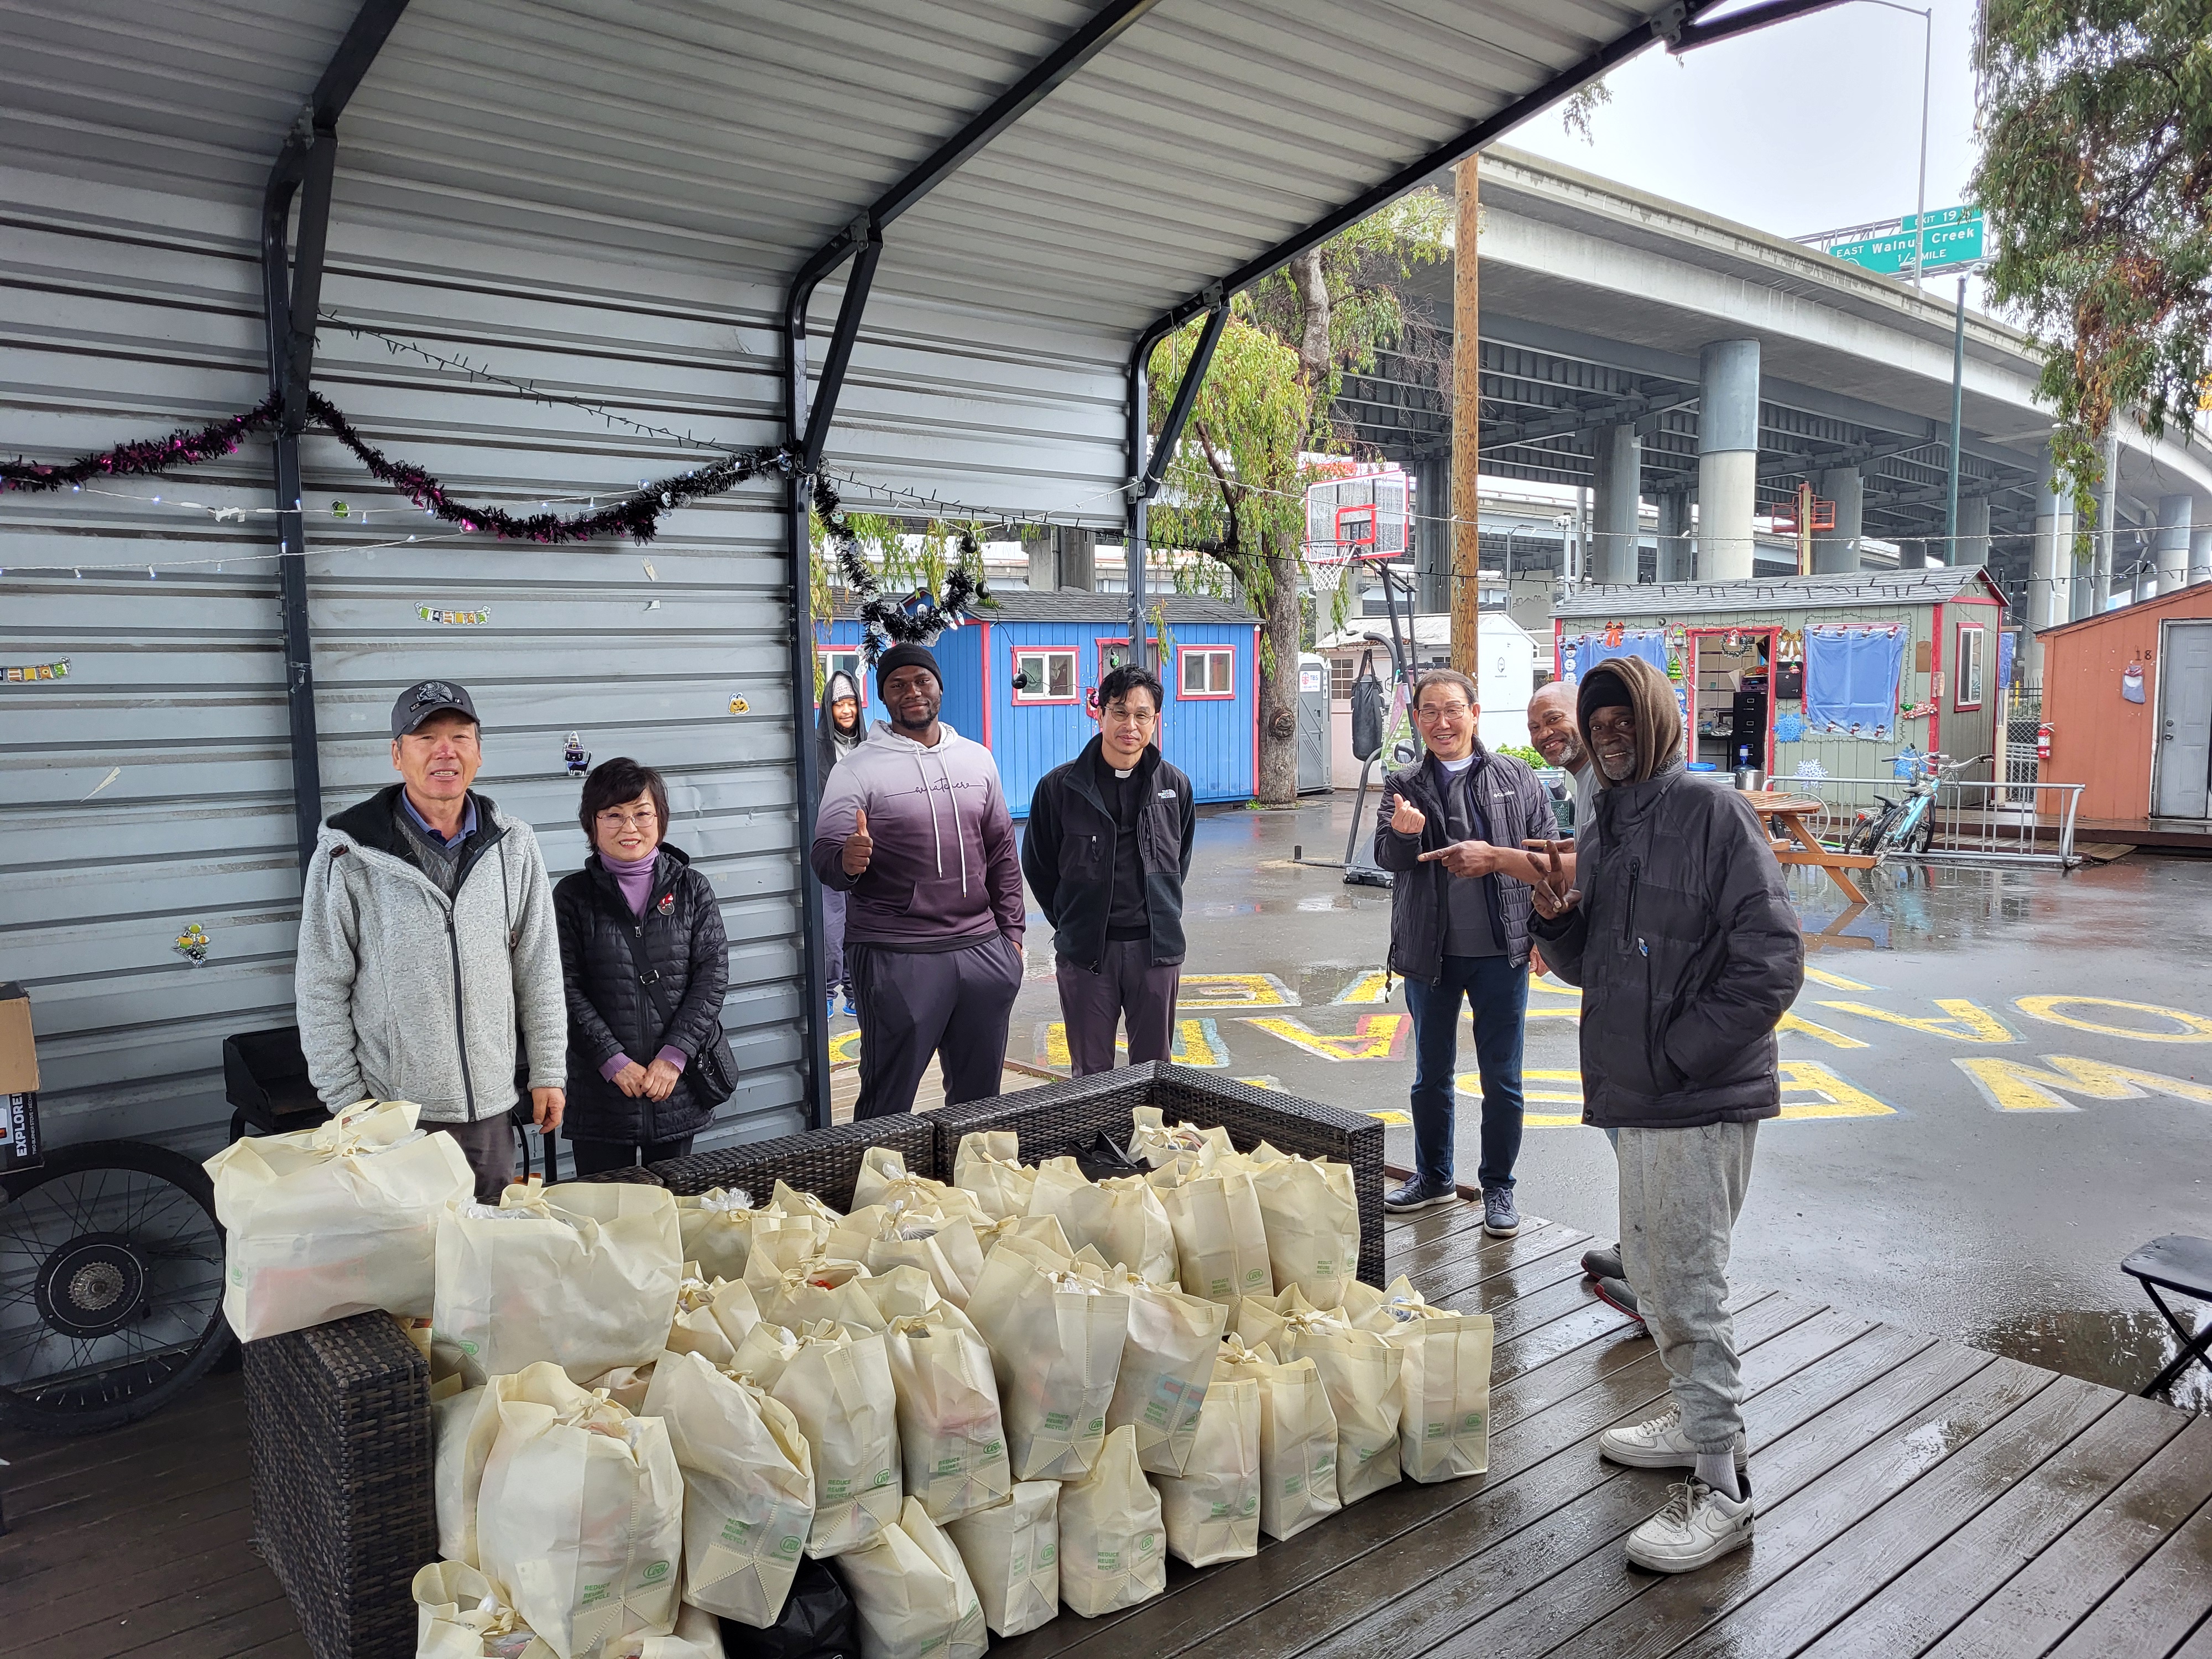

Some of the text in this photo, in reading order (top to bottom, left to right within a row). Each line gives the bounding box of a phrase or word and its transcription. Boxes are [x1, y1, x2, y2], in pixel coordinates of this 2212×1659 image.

[1837, 227, 1974, 258] EAST Walnu Creek
[1921, 249, 1947, 261] MILE
[1045, 1423, 1068, 1432] RECYCLE
[724, 1524, 744, 1536] REUSE
[721, 1531, 748, 1546] RECYCLE
